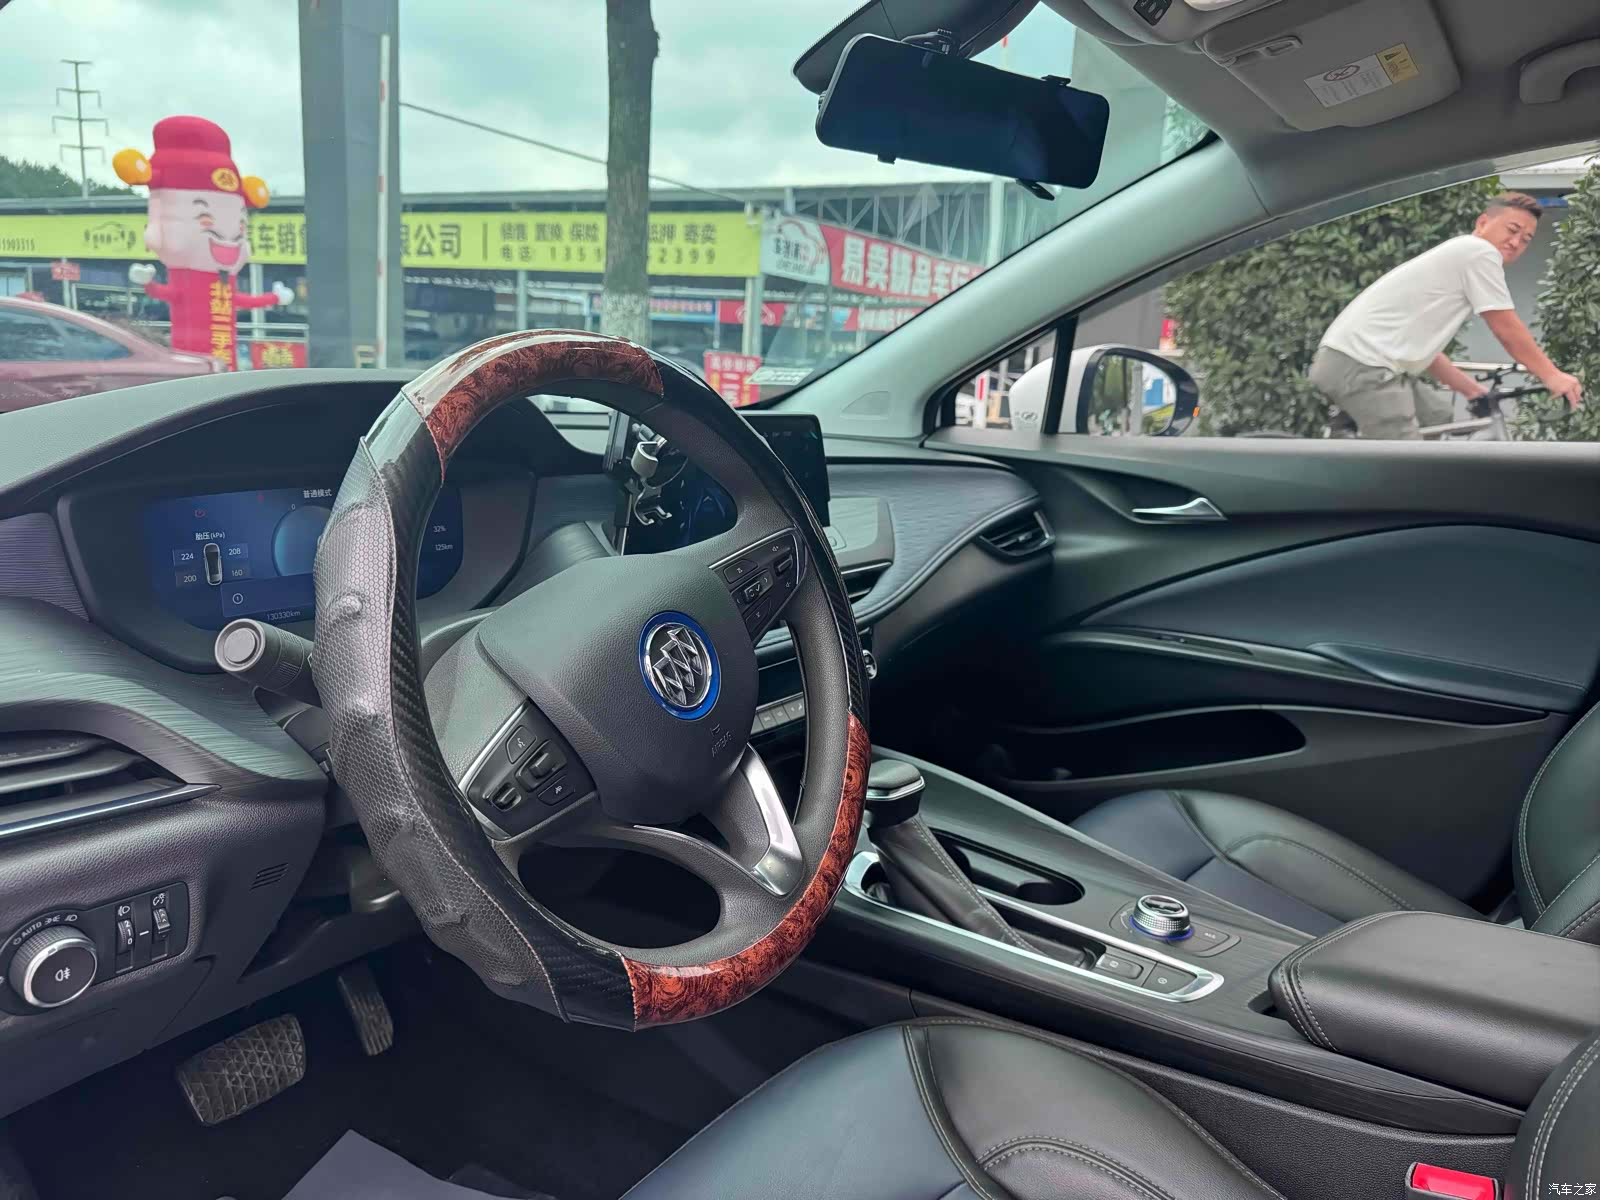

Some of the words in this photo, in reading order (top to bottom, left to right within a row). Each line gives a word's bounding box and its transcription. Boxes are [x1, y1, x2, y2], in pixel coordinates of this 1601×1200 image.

[840, 235, 979, 300] 易卖精品车
[303, 488, 333, 499] 普通模式
[195, 531, 226, 541] 胎压(kPa)
[181, 552, 194, 561] 224
[228, 547, 241, 556] 208
[183, 574, 197, 583] 200
[231, 569, 243, 577] 160
[266, 610, 301, 621] 130330km
[21, 921, 42, 938] AUTO
[124, 919, 131, 928] 2
